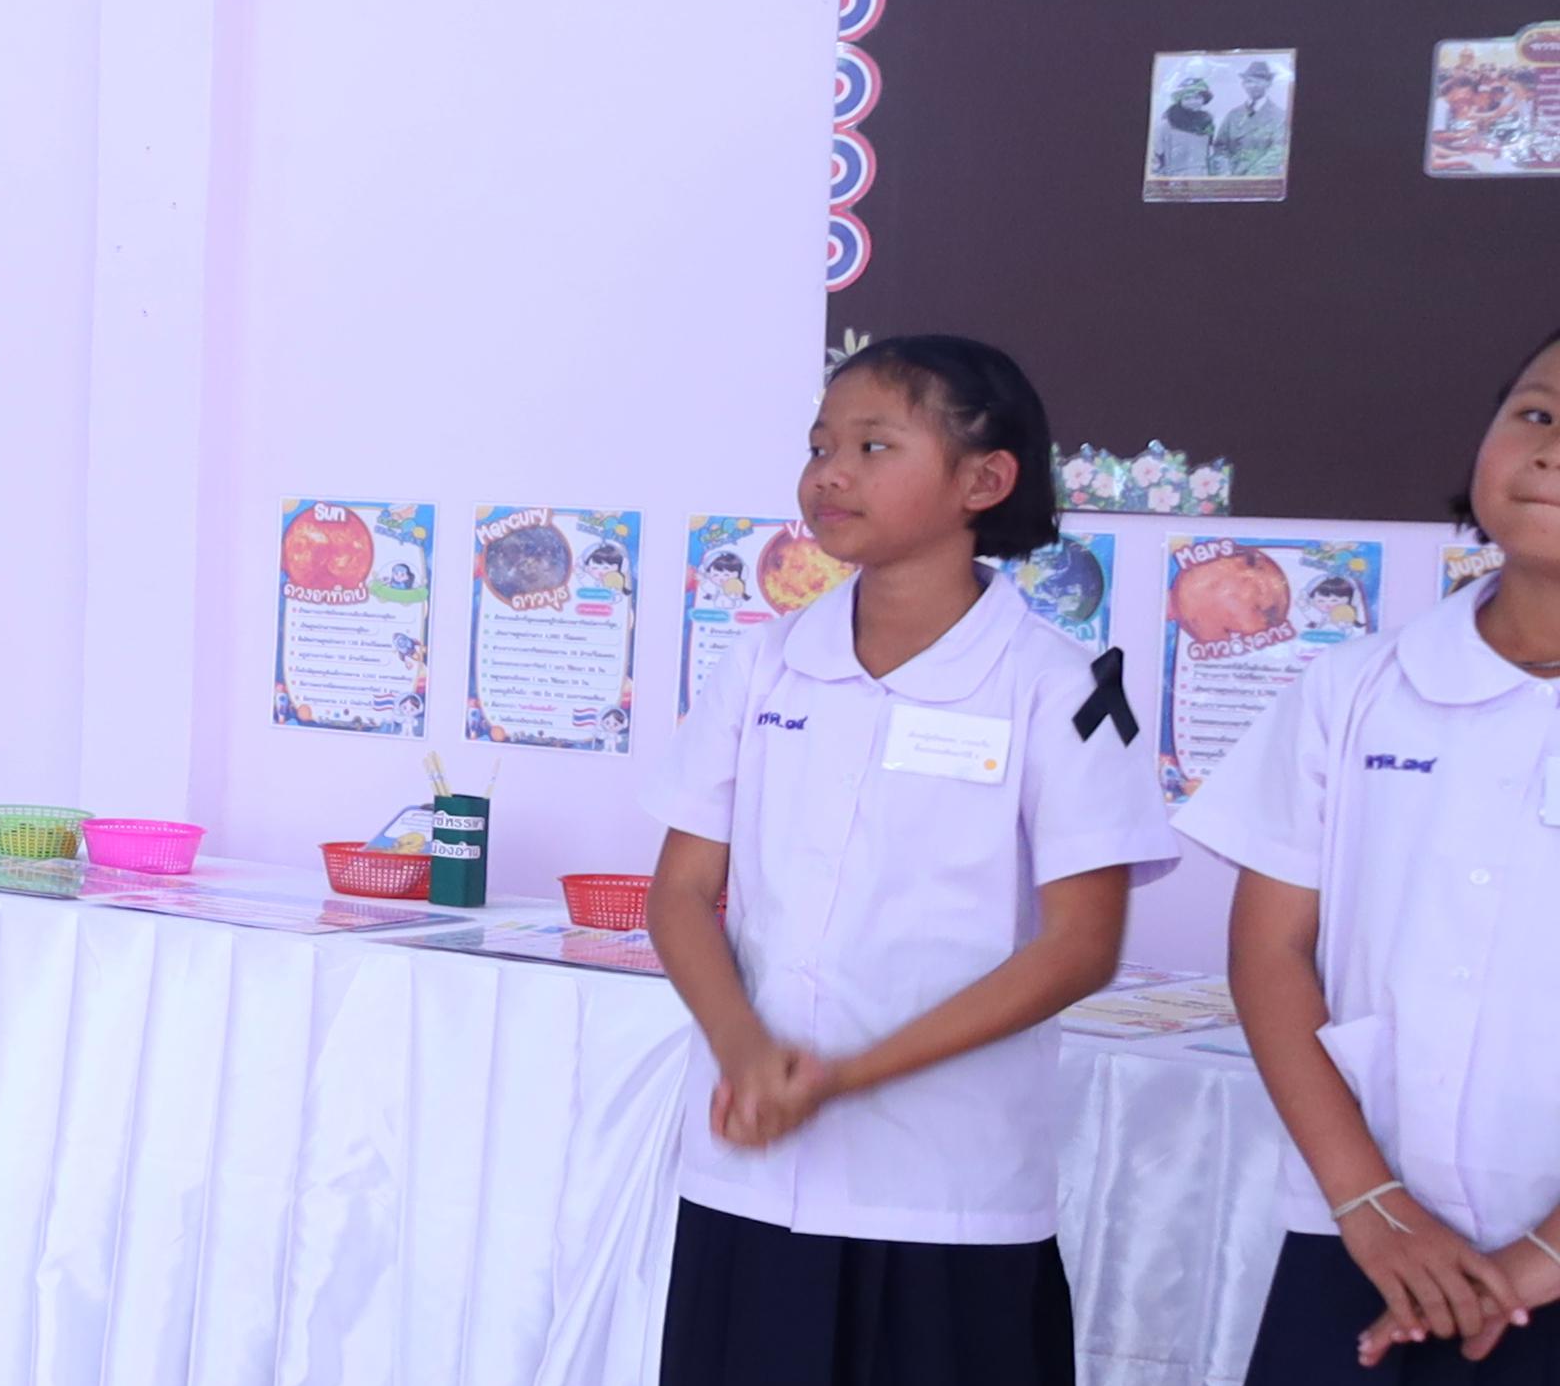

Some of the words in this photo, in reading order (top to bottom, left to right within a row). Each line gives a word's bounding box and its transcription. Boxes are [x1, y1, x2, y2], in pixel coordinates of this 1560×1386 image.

[314, 503, 347, 522] Sun
[475, 507, 549, 545] Mercury
[1175, 539, 1234, 570] Mars
[283, 582, 368, 603] ดวงอาทิตย์
[511, 586, 569, 610] ดาวพุธ
[1188, 621, 1294, 659] ดาวอังคาร
